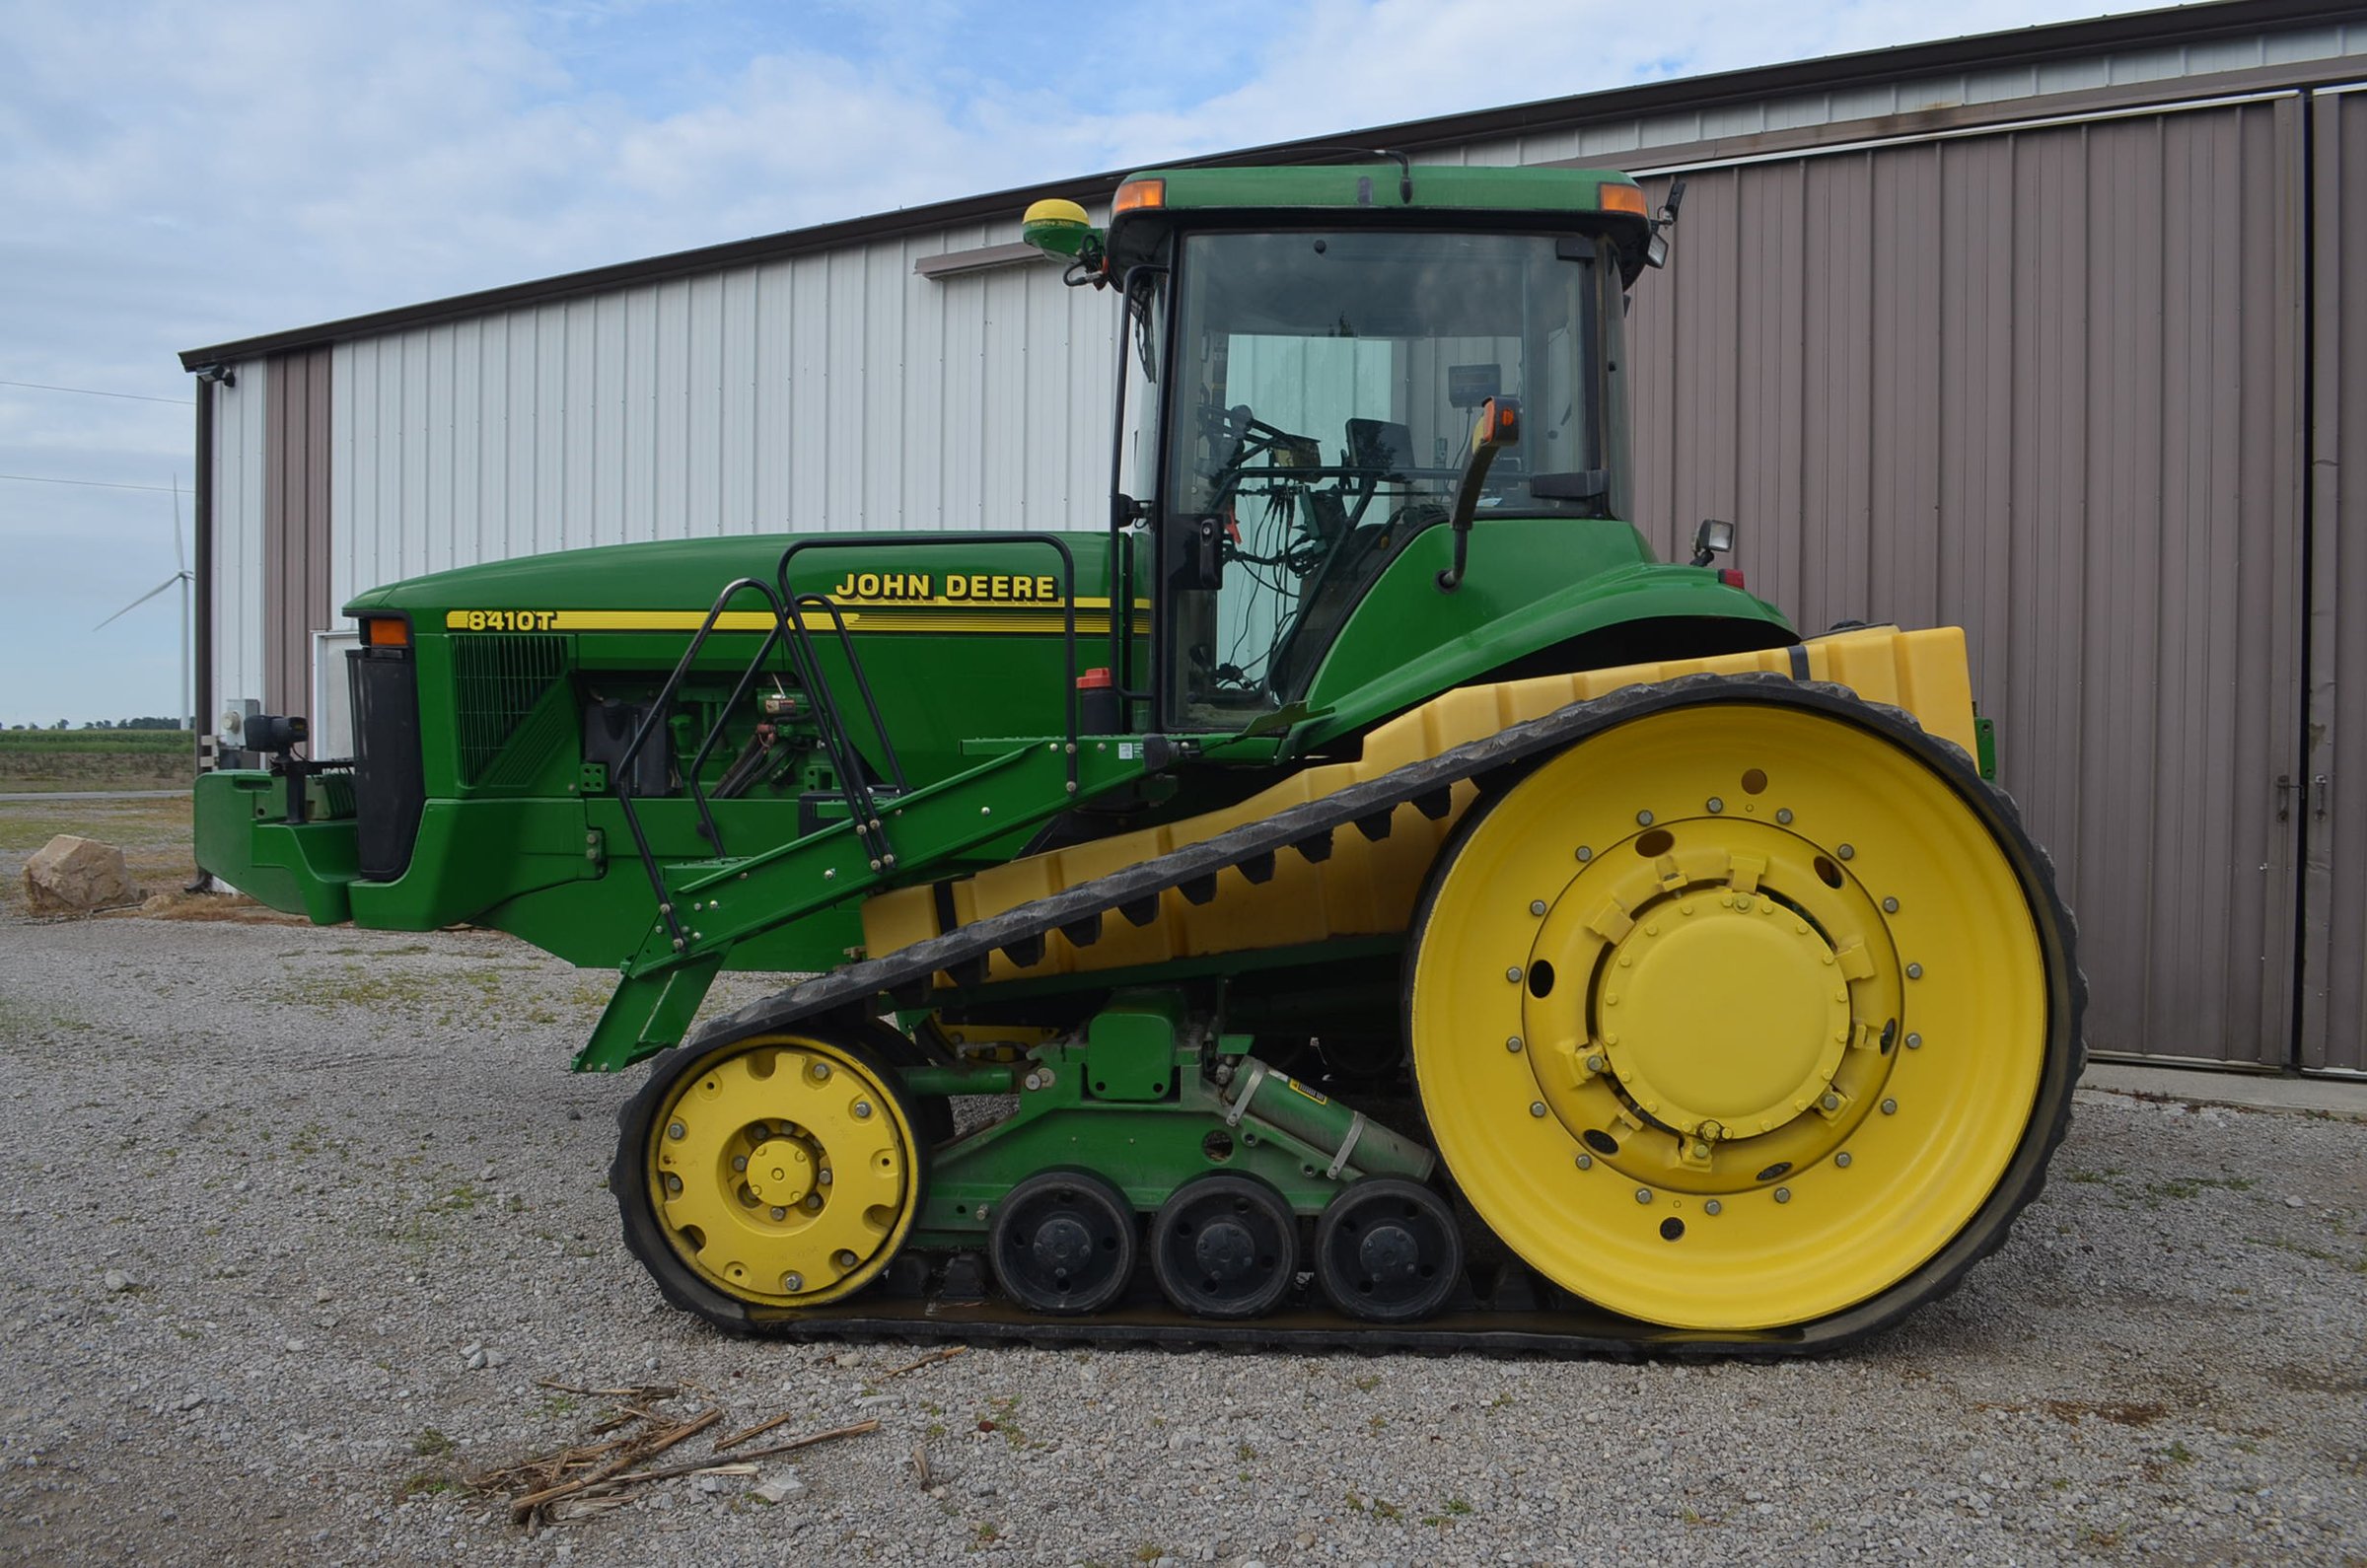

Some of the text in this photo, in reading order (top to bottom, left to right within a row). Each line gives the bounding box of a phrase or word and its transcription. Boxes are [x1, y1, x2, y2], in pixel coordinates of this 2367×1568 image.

[835, 573, 1056, 601] JOHN DEERE
[468, 609, 554, 631] 8410T
